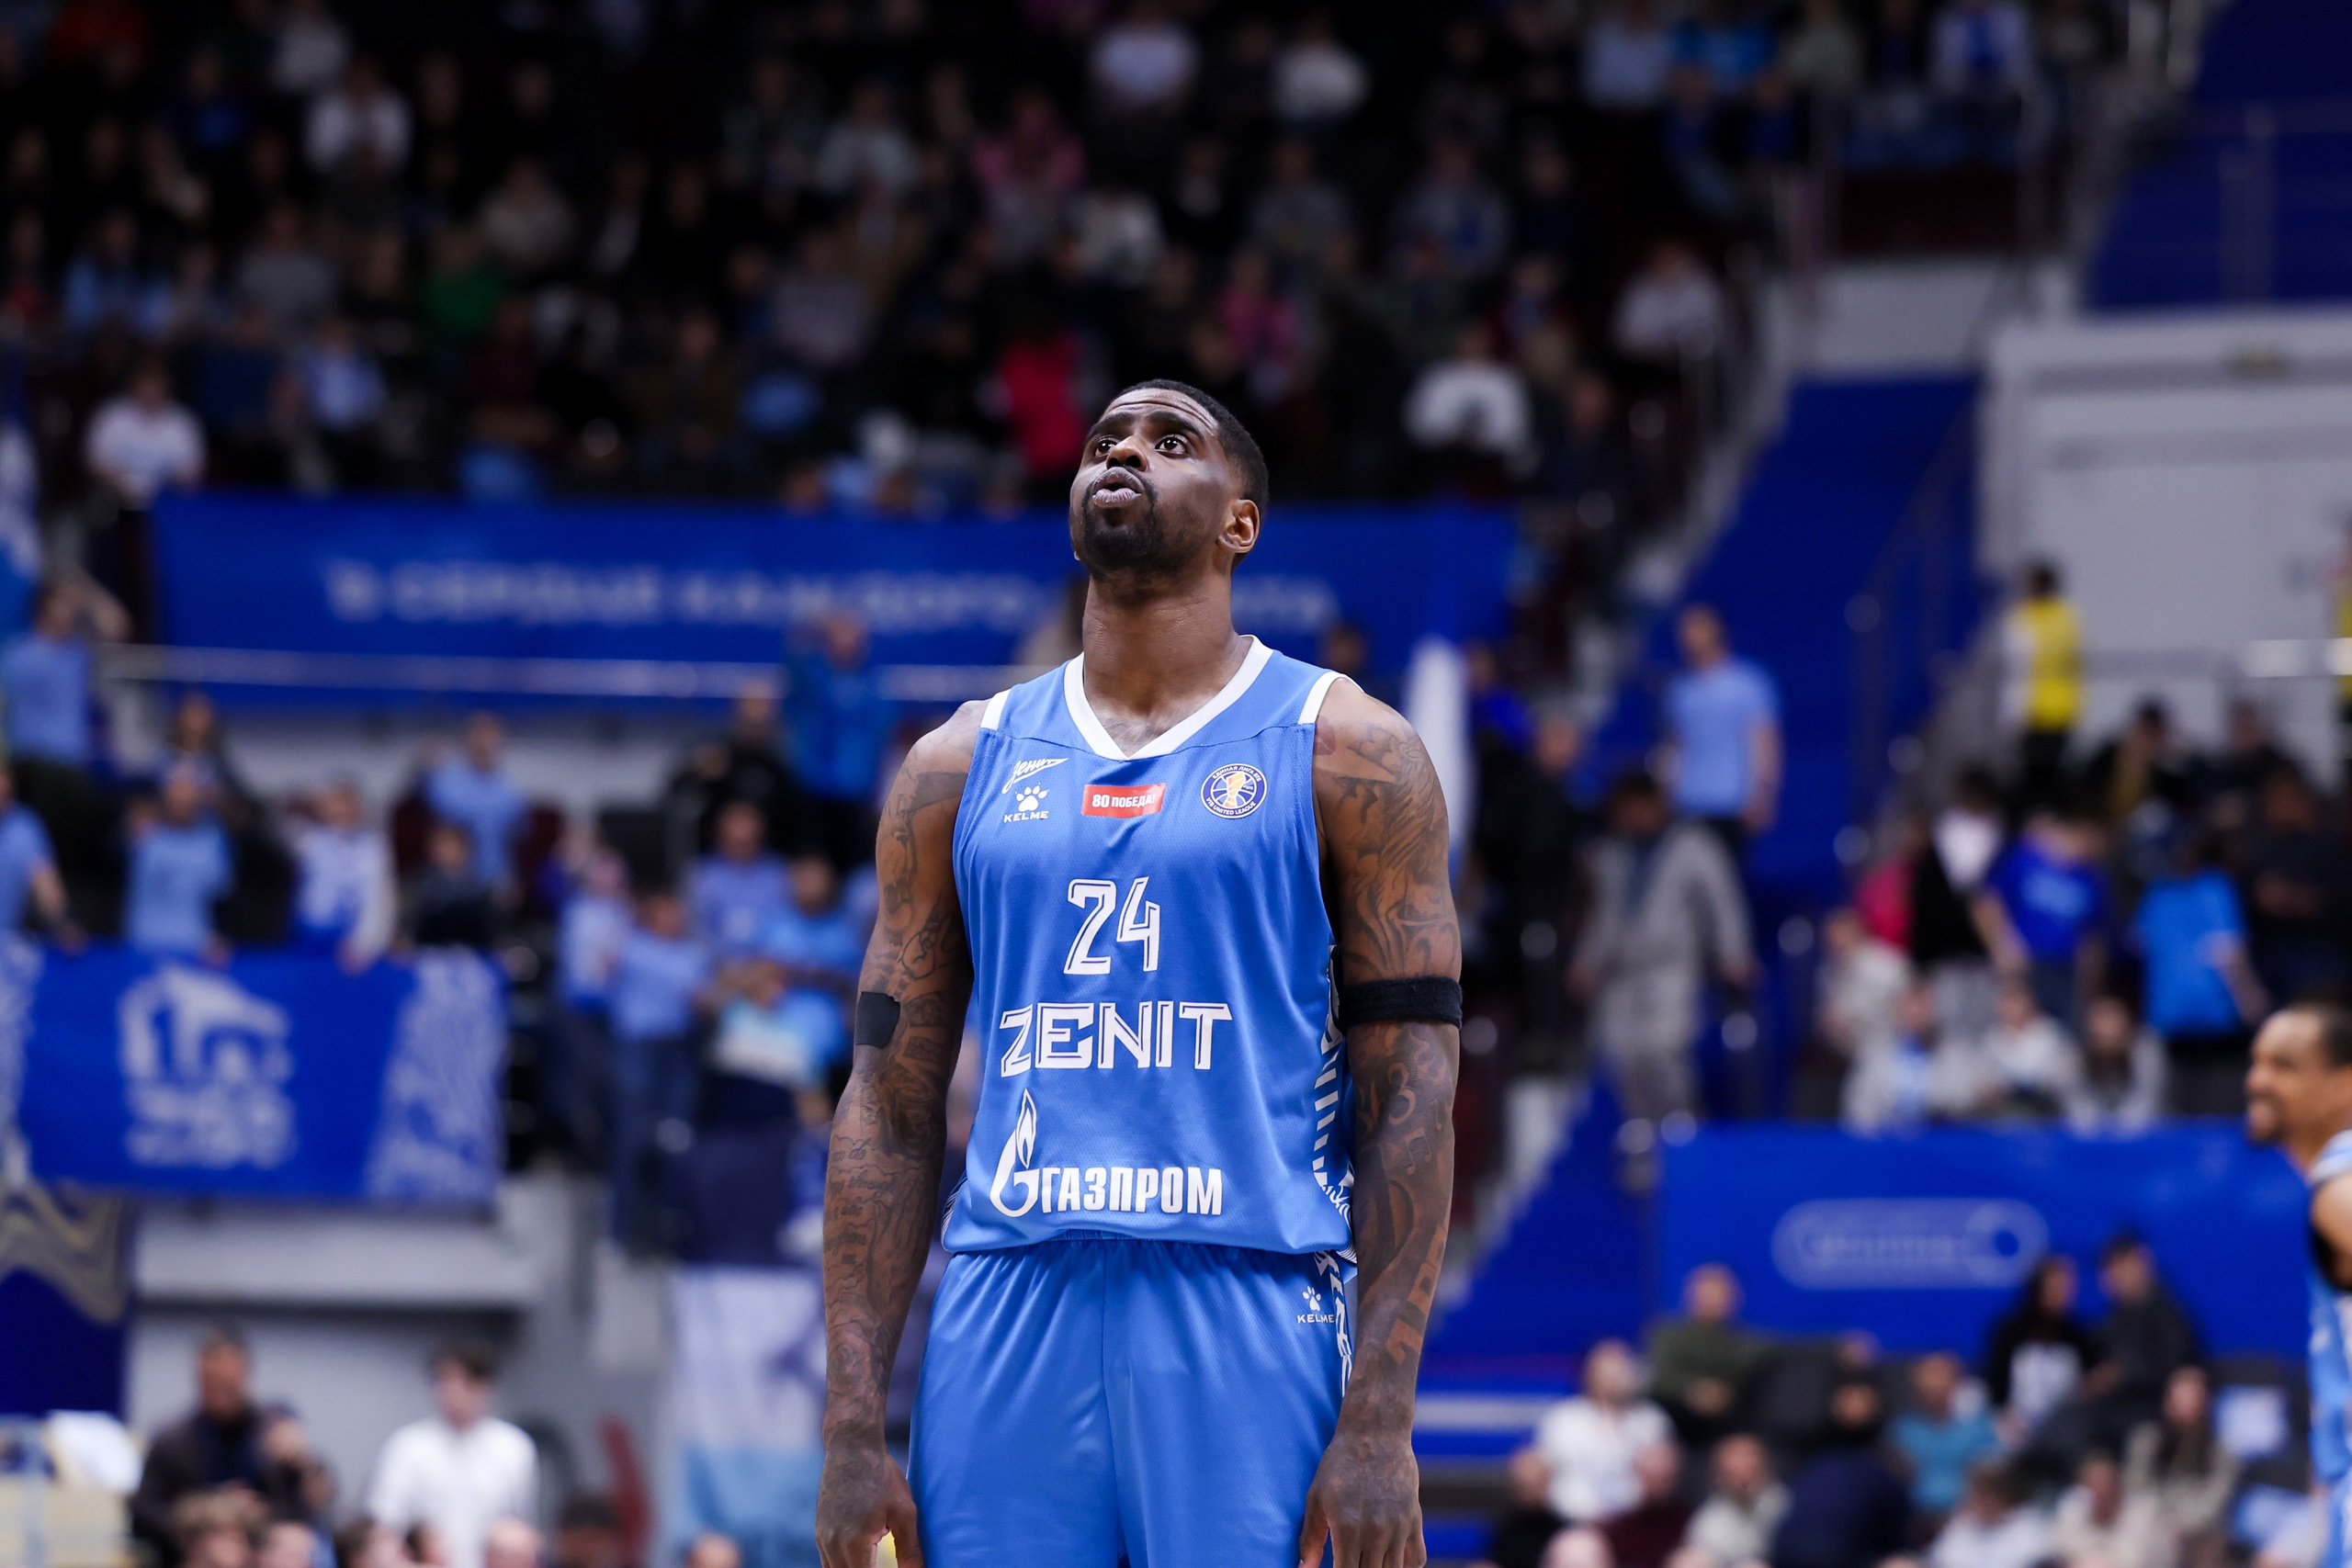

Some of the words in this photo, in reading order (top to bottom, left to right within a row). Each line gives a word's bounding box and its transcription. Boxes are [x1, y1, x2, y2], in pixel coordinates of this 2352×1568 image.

[1212, 766, 1238, 780] ЕДИННАЯ
[1238, 766, 1254, 774] ЛИГА
[1252, 773, 1262, 783] ВТБ
[1091, 794, 1111, 808] 80
[1111, 794, 1157, 808] ПОБЕДА!
[1205, 796, 1215, 807] VTB
[1213, 804, 1235, 816] UNITED
[1235, 801, 1257, 815] LEAGUE
[1003, 810, 1050, 824] KELME
[1063, 875, 1160, 976] 24
[999, 1000, 1233, 1078] ZENIT
[1041, 1166, 1223, 1216] ГАЗПРОМ
[1296, 1313, 1335, 1325] KELME
